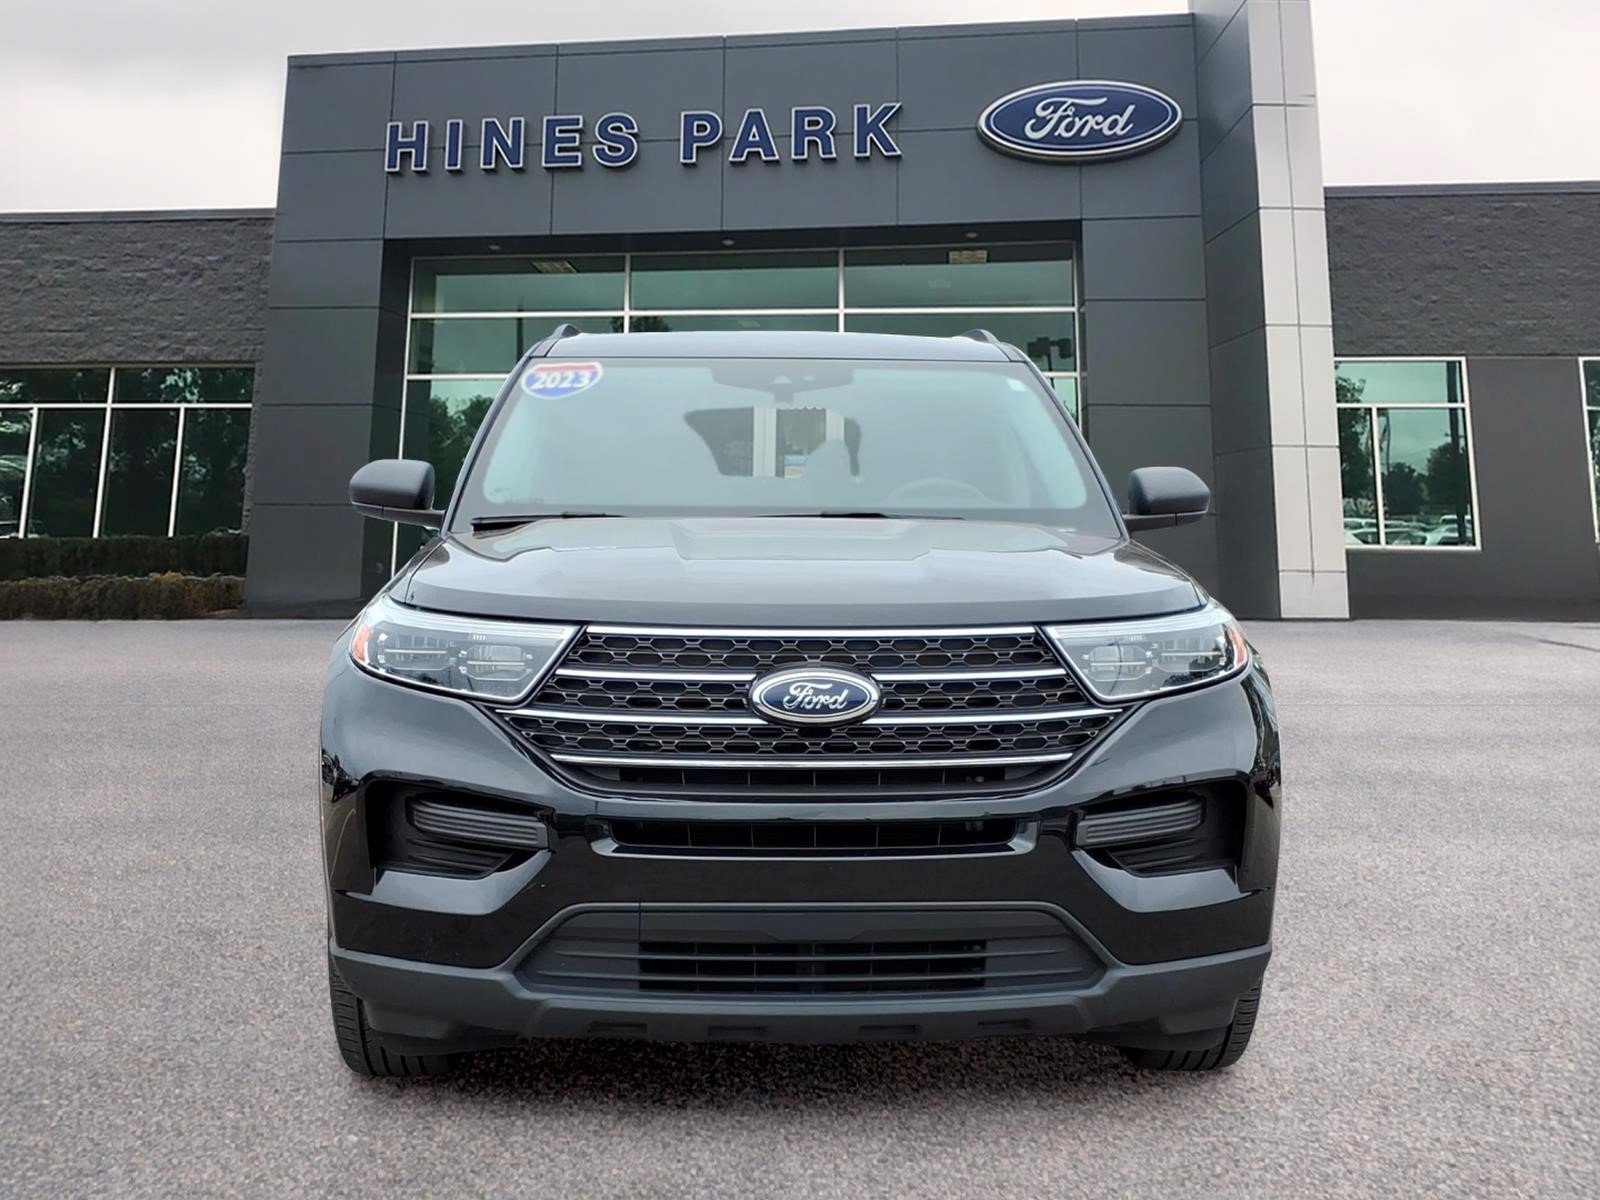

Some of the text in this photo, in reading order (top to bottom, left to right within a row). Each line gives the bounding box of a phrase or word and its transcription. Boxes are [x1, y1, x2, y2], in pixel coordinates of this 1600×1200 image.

[1024, 97, 1136, 139] Ford
[385, 102, 902, 172] HINES PARK
[529, 370, 593, 390] 2023
[783, 682, 849, 710] Ford
